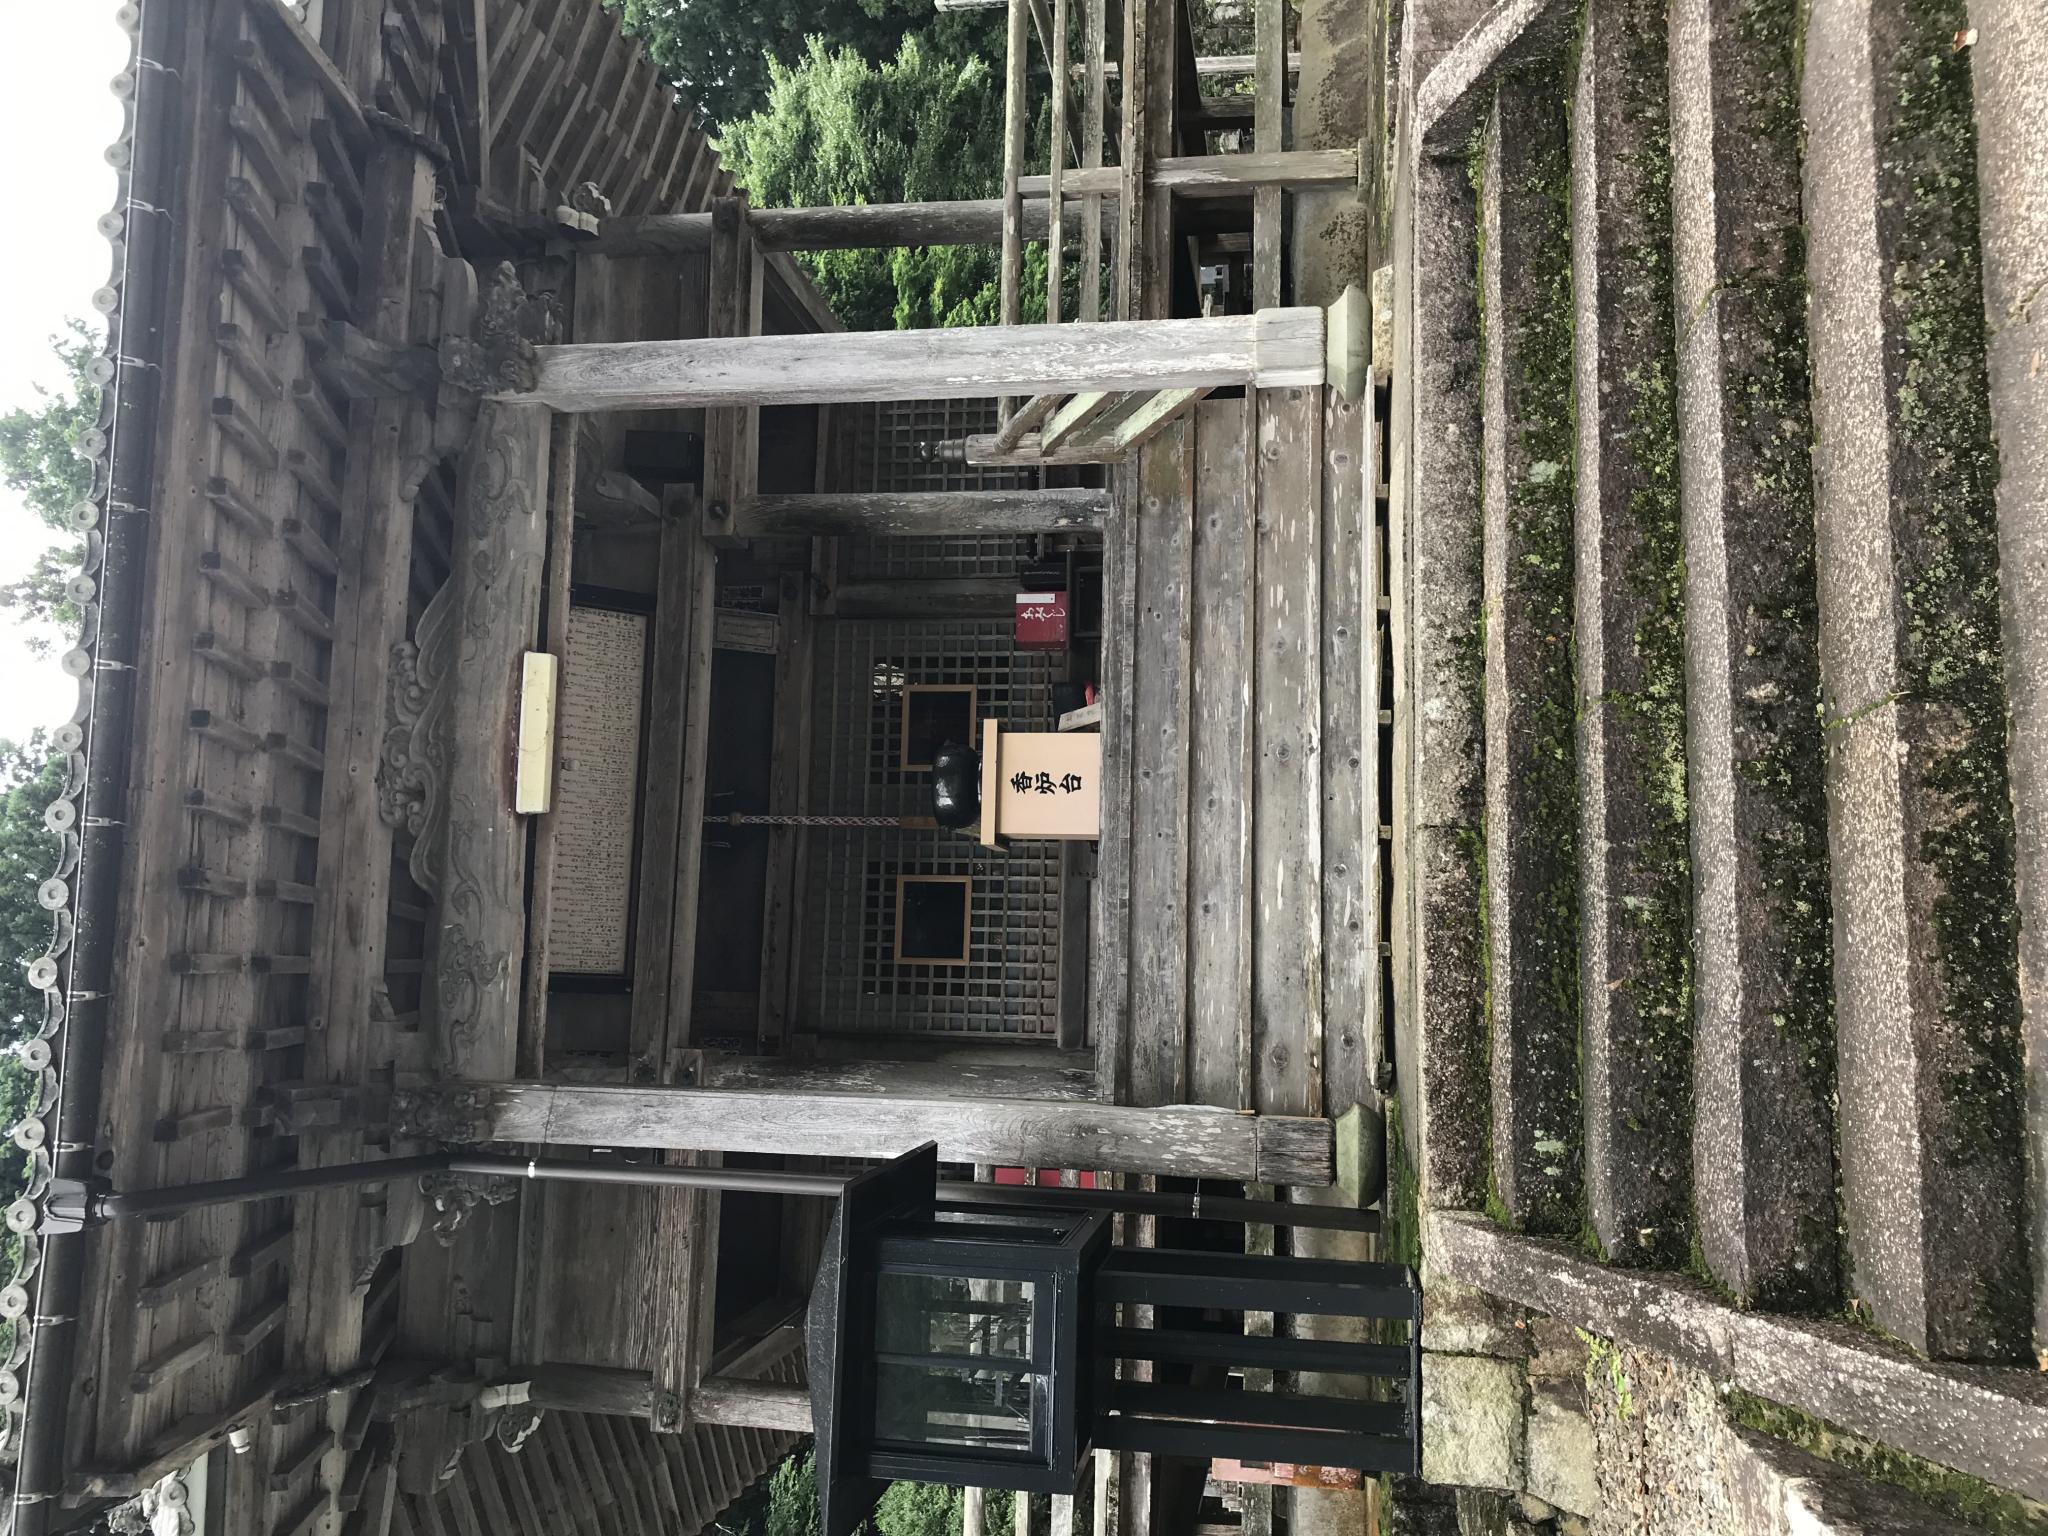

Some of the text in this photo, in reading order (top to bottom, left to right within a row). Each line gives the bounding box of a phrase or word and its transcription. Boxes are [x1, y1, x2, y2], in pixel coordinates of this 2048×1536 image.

[1020, 606, 1066, 622] おみくじ
[1010, 771, 1082, 795] 香炉台
